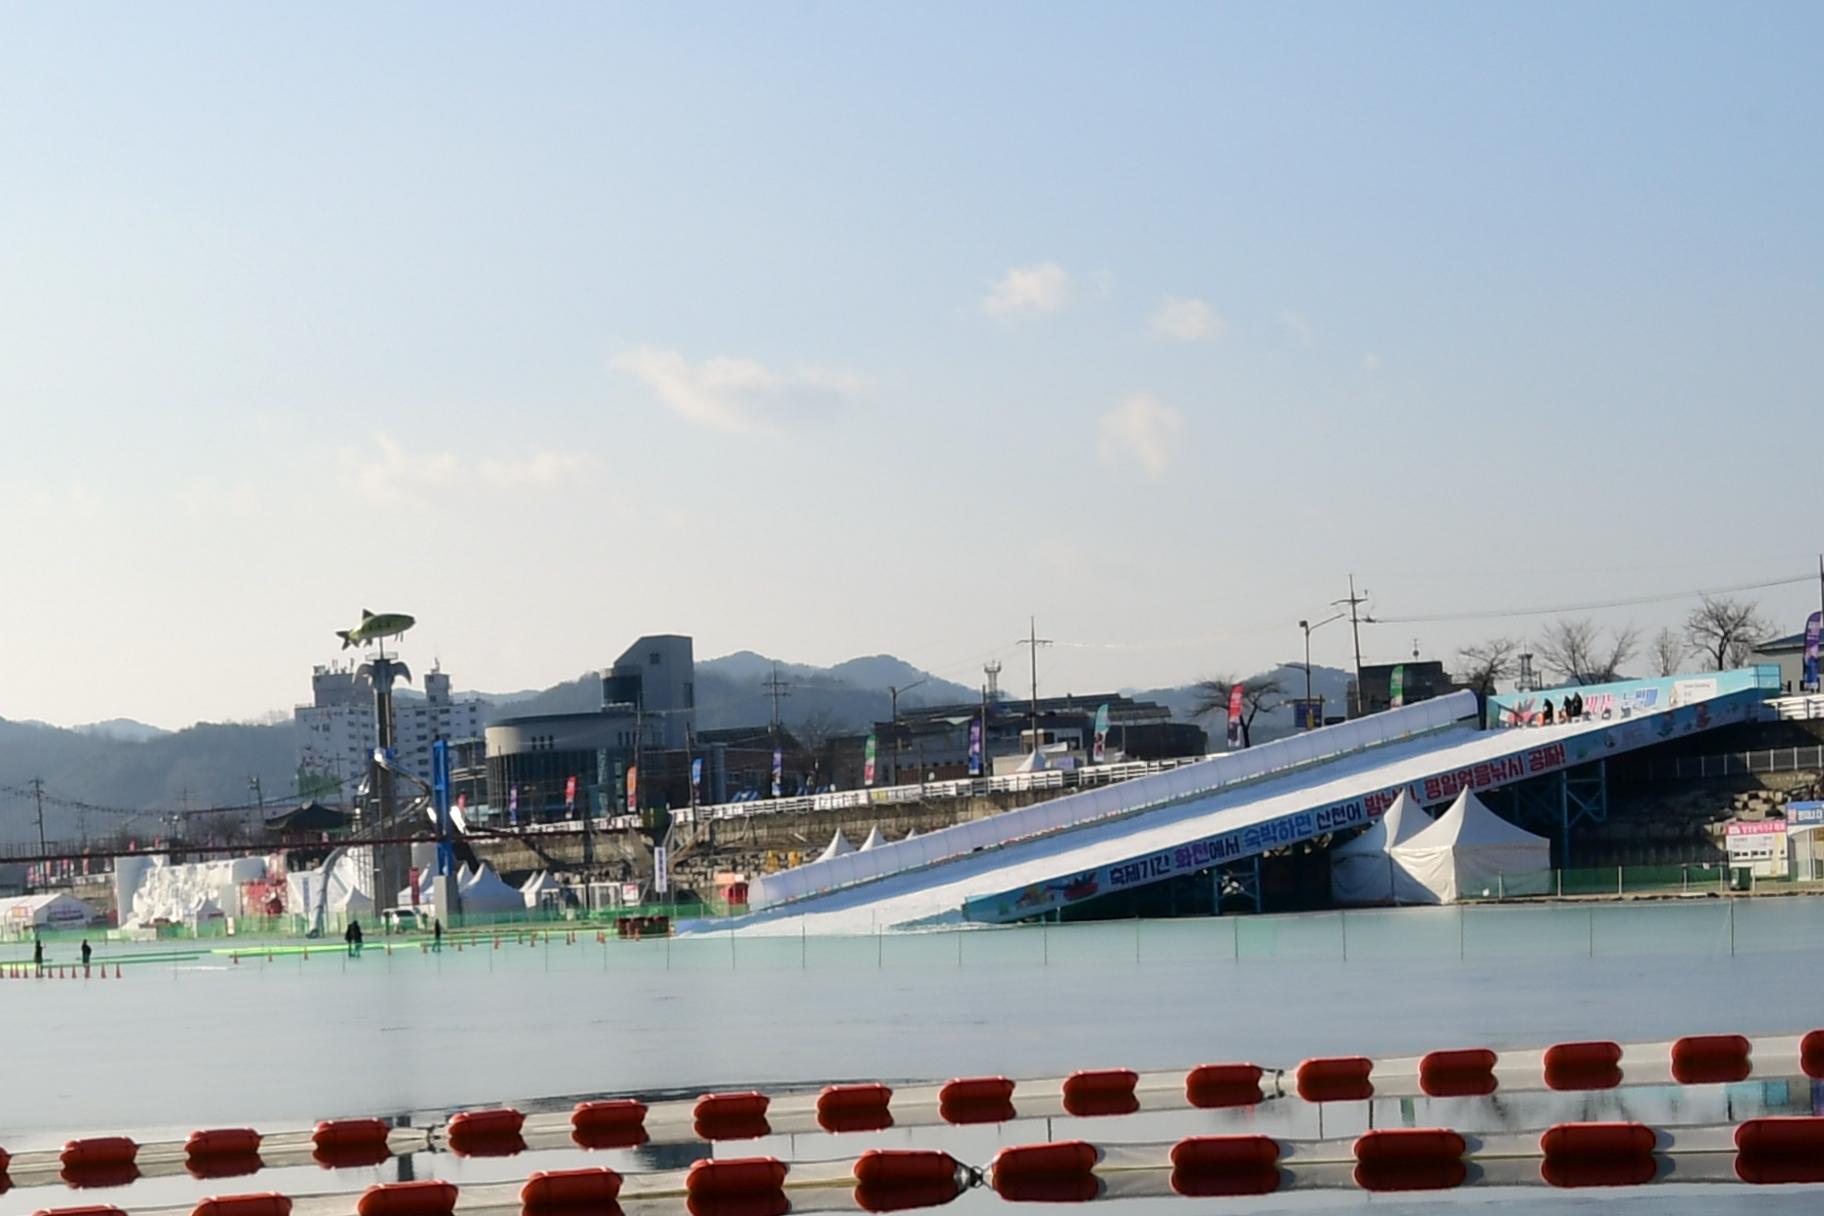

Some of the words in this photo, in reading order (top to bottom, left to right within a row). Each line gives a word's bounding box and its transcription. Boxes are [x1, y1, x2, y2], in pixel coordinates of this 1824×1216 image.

[1109, 855, 1170, 886] 축제기간
[1175, 836, 1240, 869] 화천에서
[1243, 812, 1313, 848] 숙박하면
[1316, 802, 1362, 830] 산천어
[1528, 743, 1566, 772] 공짜!
